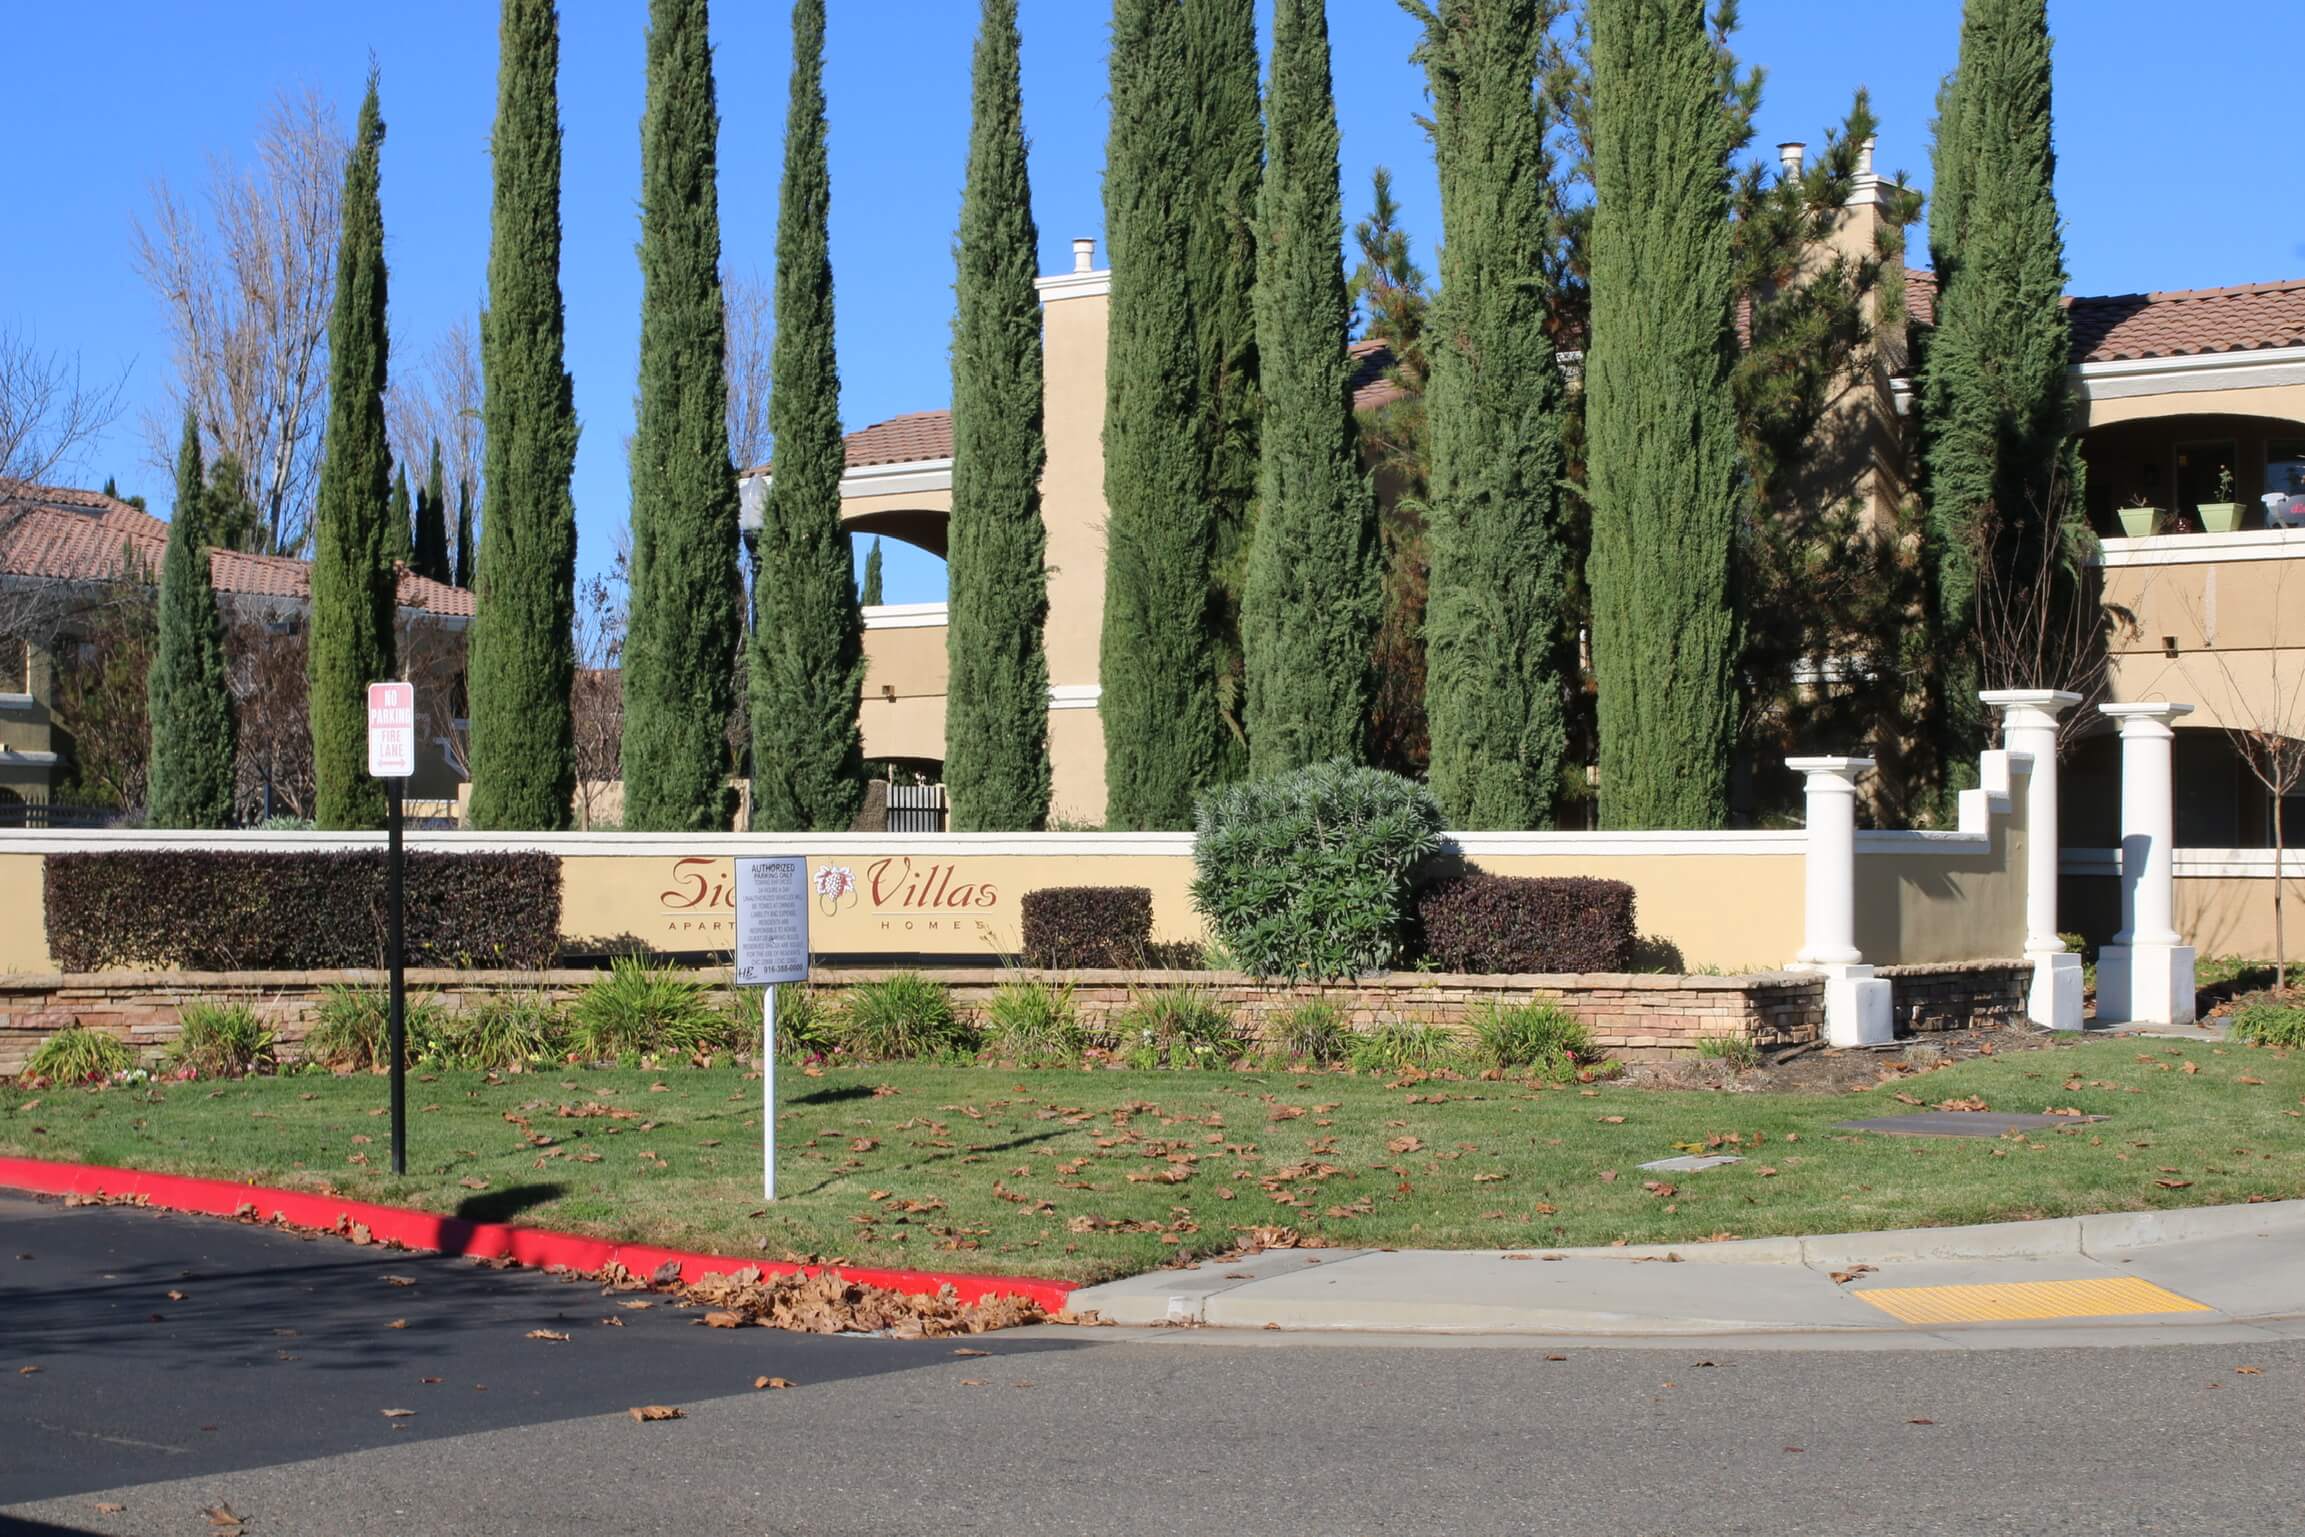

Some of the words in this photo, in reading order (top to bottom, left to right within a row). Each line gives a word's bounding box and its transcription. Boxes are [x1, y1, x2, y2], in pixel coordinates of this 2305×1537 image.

[384, 689, 399, 706] NO
[371, 708, 411, 724] PARKING
[382, 730, 401, 743] FIRE
[380, 743, 403, 757] LANE
[752, 864, 795, 872] AUTHORIZED
[867, 857, 999, 907] Villas
[881, 920, 985, 930] HOMES
